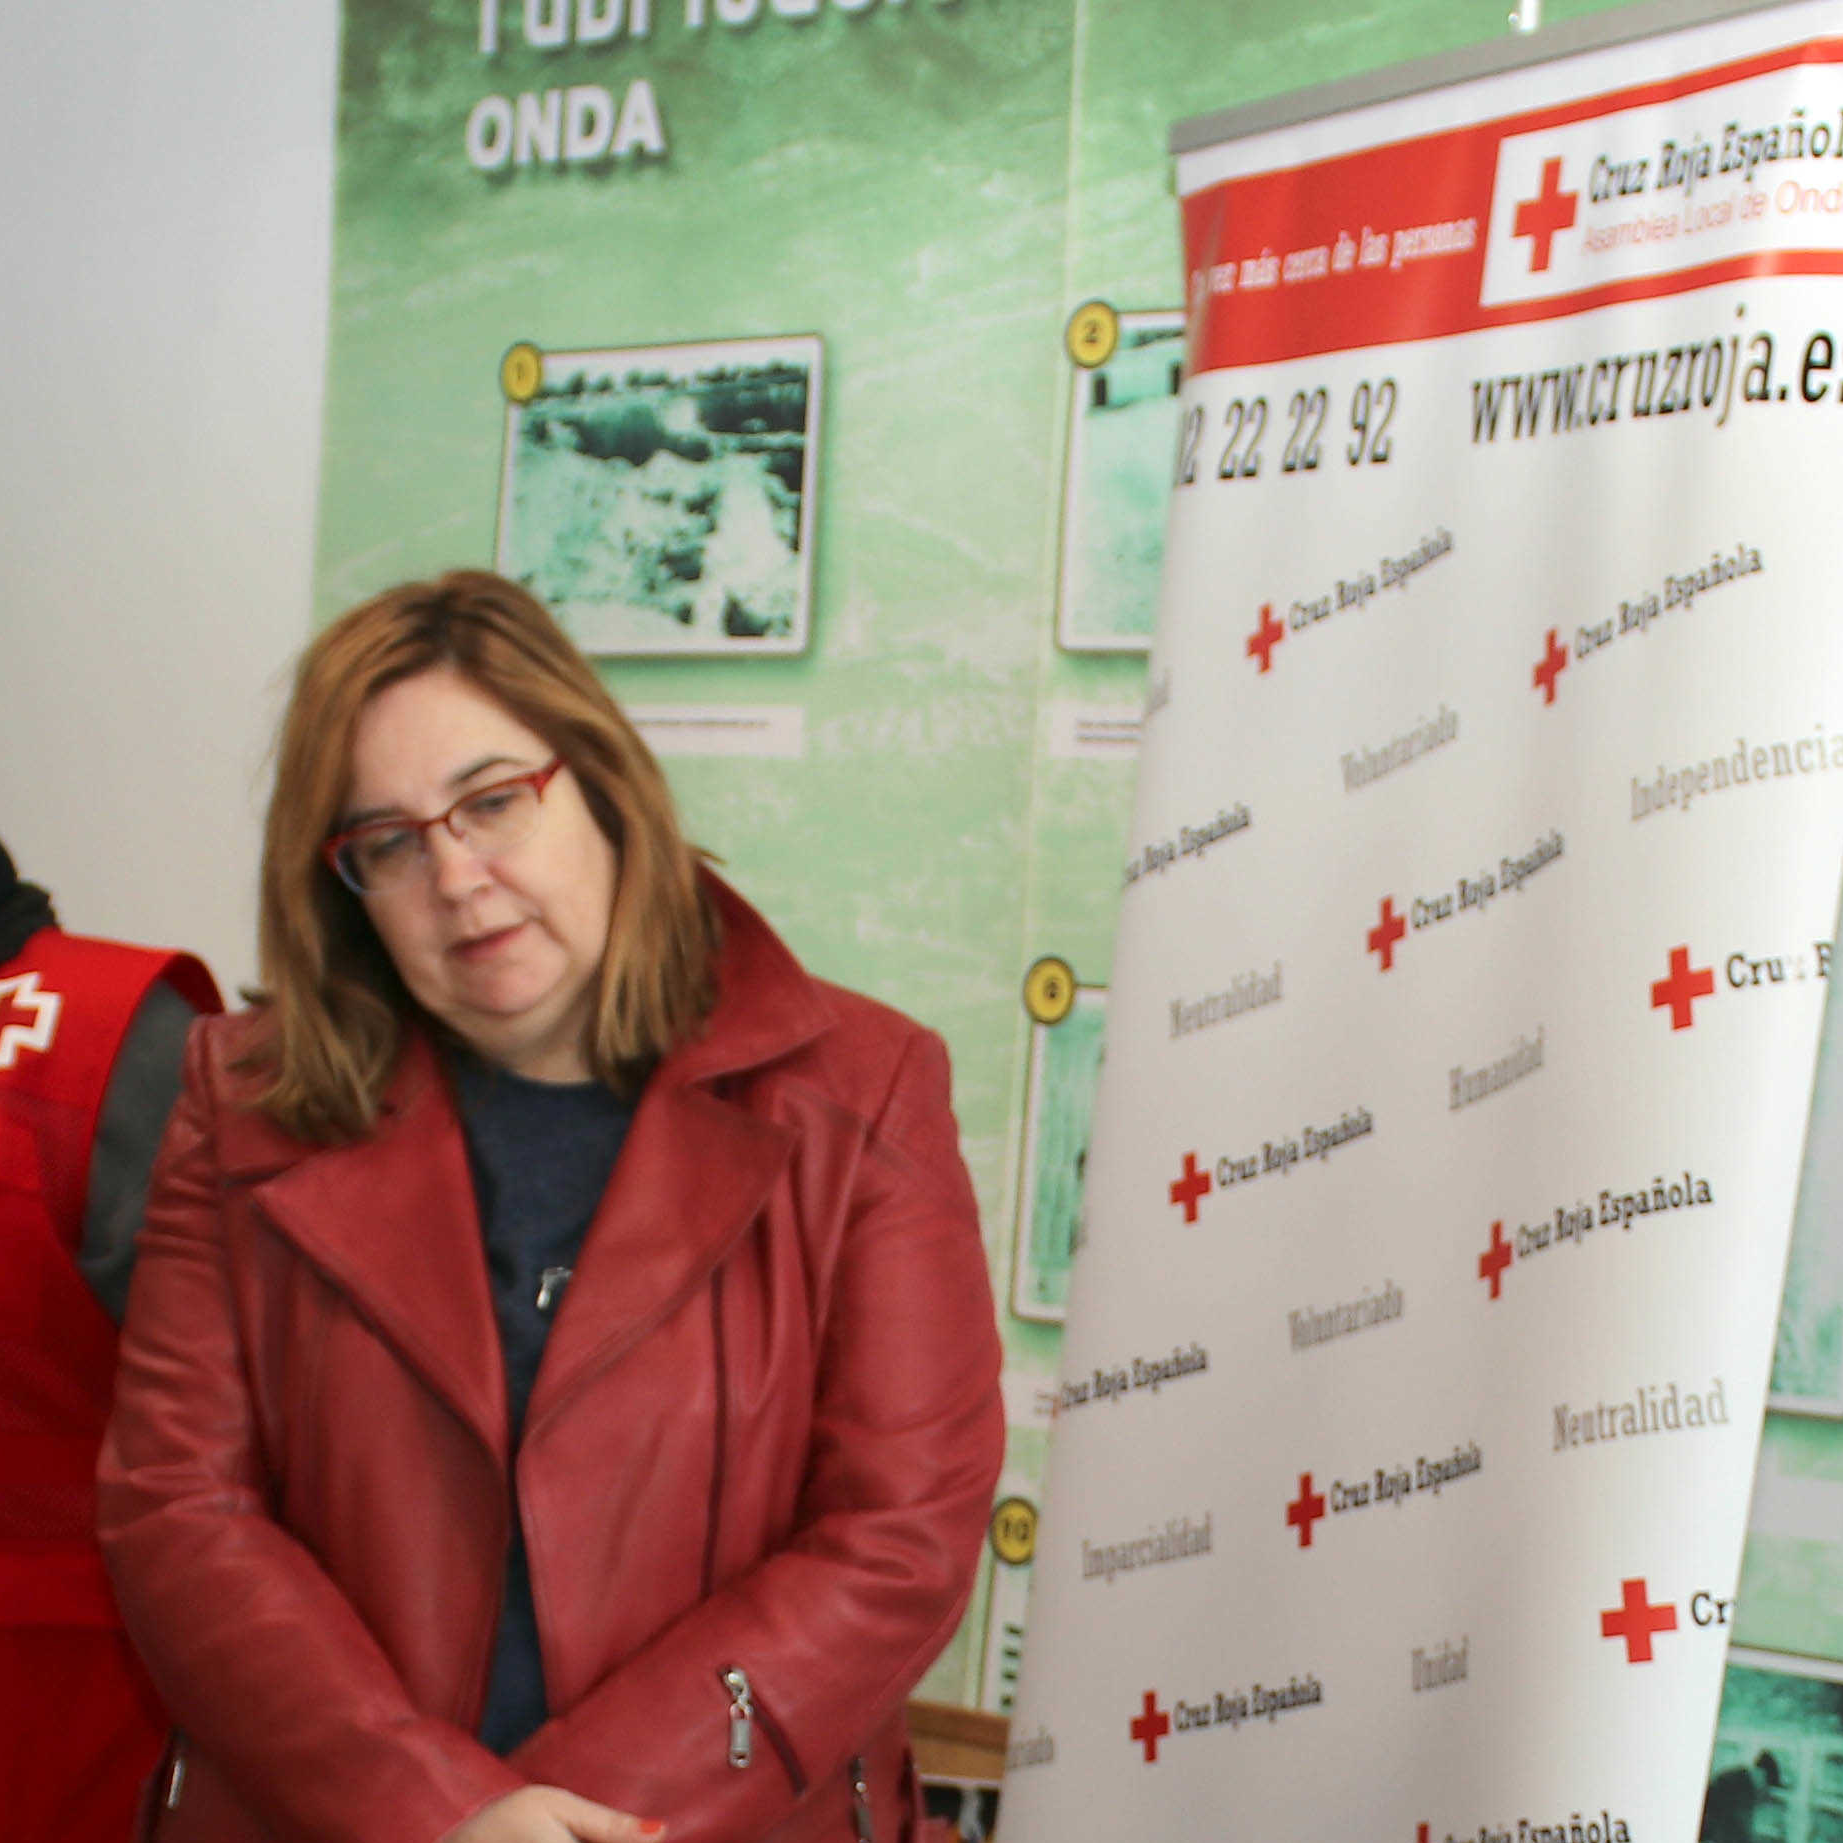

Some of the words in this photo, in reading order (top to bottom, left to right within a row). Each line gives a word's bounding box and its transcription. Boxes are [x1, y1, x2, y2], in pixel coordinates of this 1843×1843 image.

[465, 78, 665, 170] ONDA
[1588, 153, 1649, 204] Cruz
[1655, 131, 1712, 198] Roja
[1218, 396, 1268, 481] 22
[1282, 386, 1329, 474] 22
[1347, 377, 1398, 467] 92
[1516, 1222, 1552, 1260] Cruz
[1551, 1378, 1731, 1454] Neutralidad
